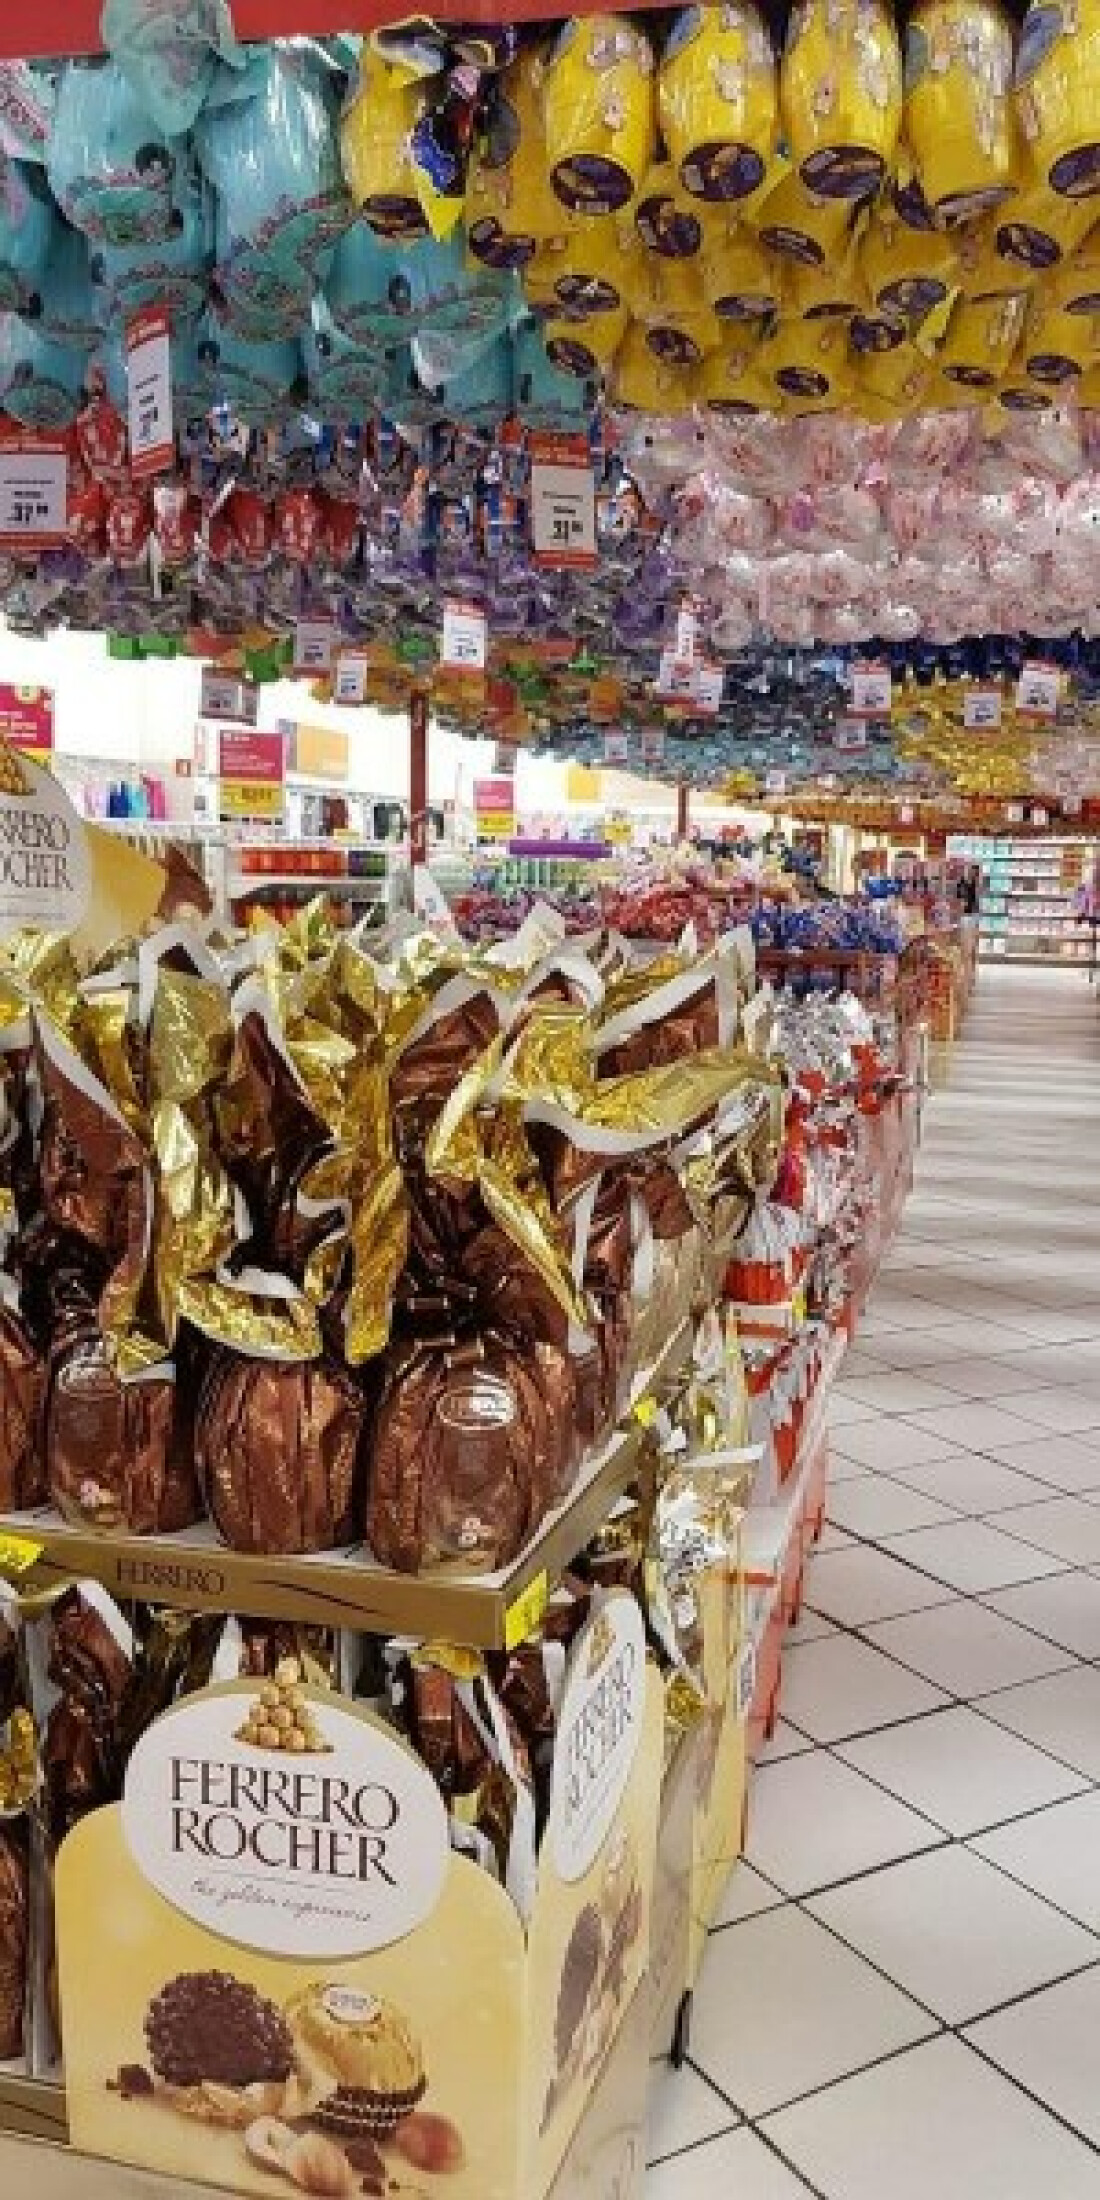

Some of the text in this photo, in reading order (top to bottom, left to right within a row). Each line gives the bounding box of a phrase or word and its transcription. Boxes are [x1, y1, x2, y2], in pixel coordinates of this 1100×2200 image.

[116, 1557, 225, 1596] FERRERO
[169, 1756, 400, 1832] FERRERO
[172, 1806, 397, 1886] ROCHER
